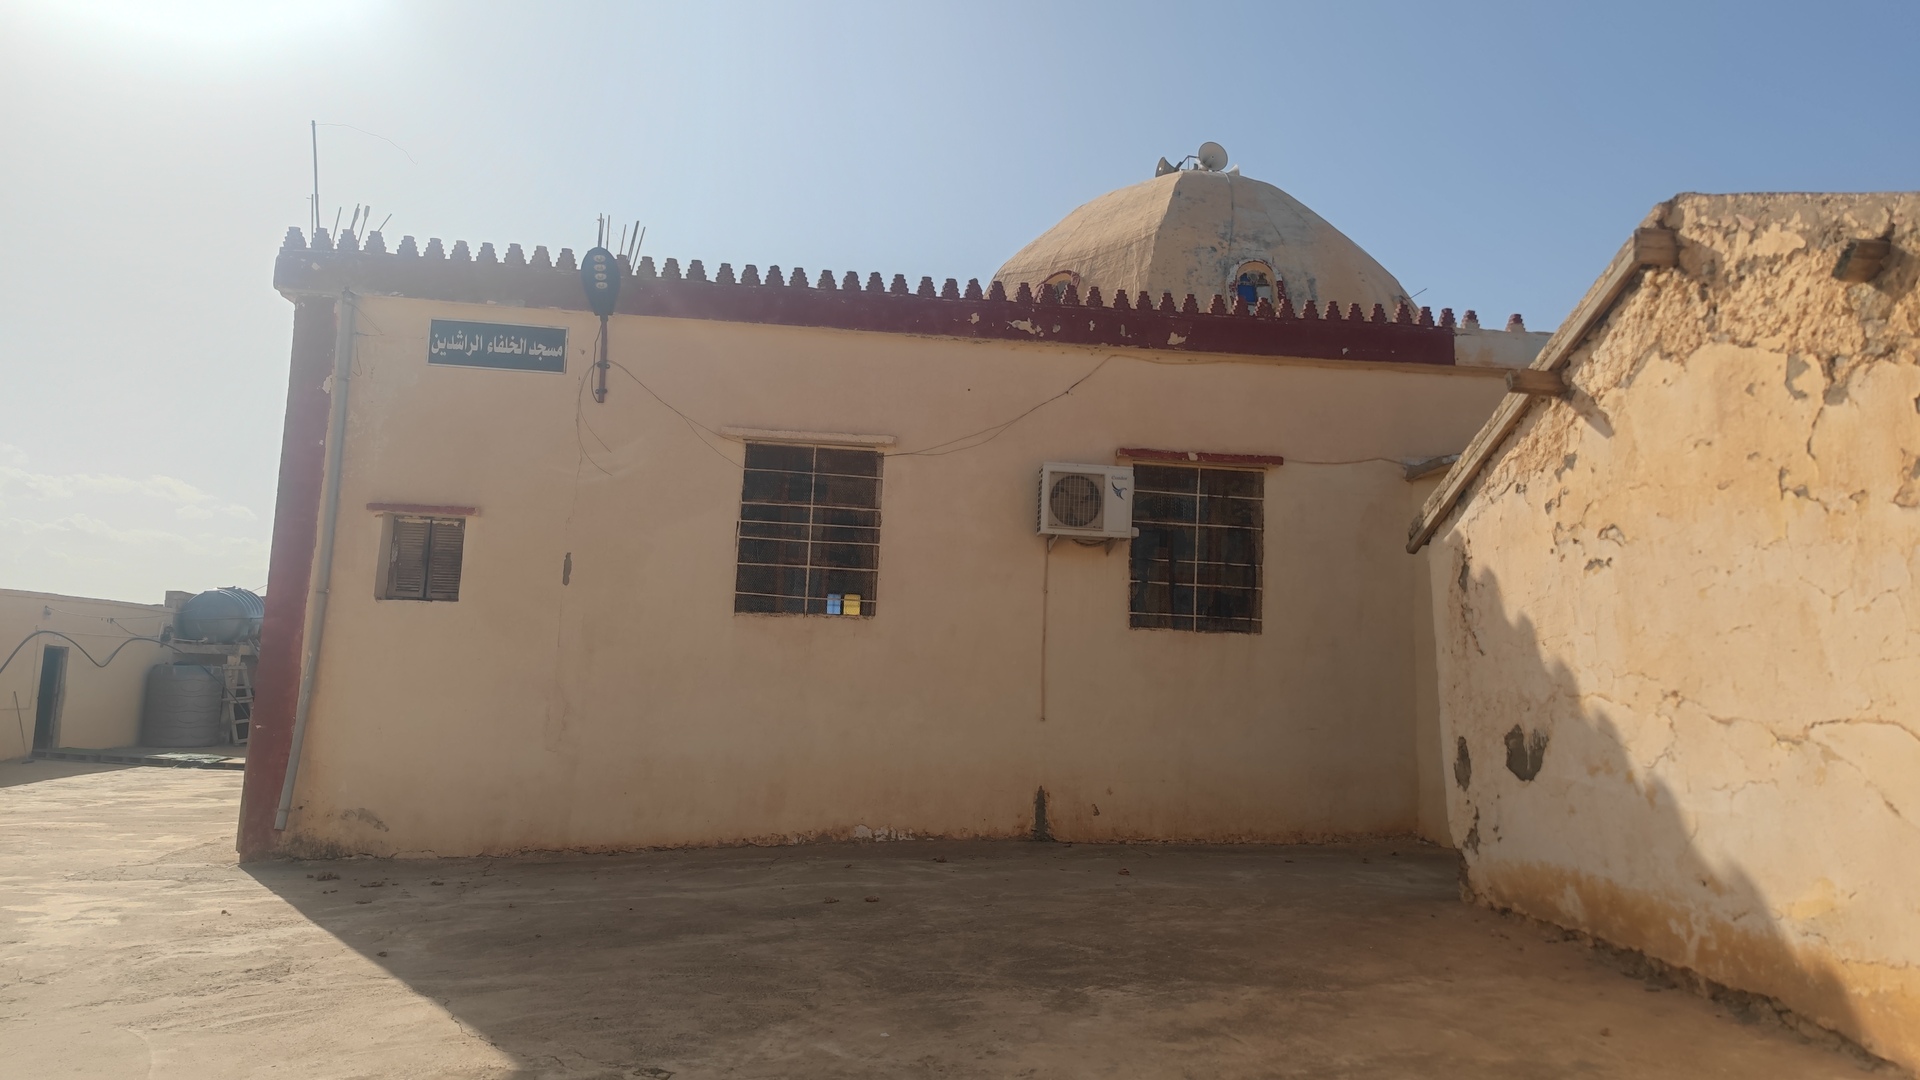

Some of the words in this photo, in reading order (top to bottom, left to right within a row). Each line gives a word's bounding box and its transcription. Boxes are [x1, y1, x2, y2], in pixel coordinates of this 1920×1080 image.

[431, 330, 483, 356] الراشدين
[487, 334, 527, 355] الخلفاء
[528, 340, 563, 361] مسجد
